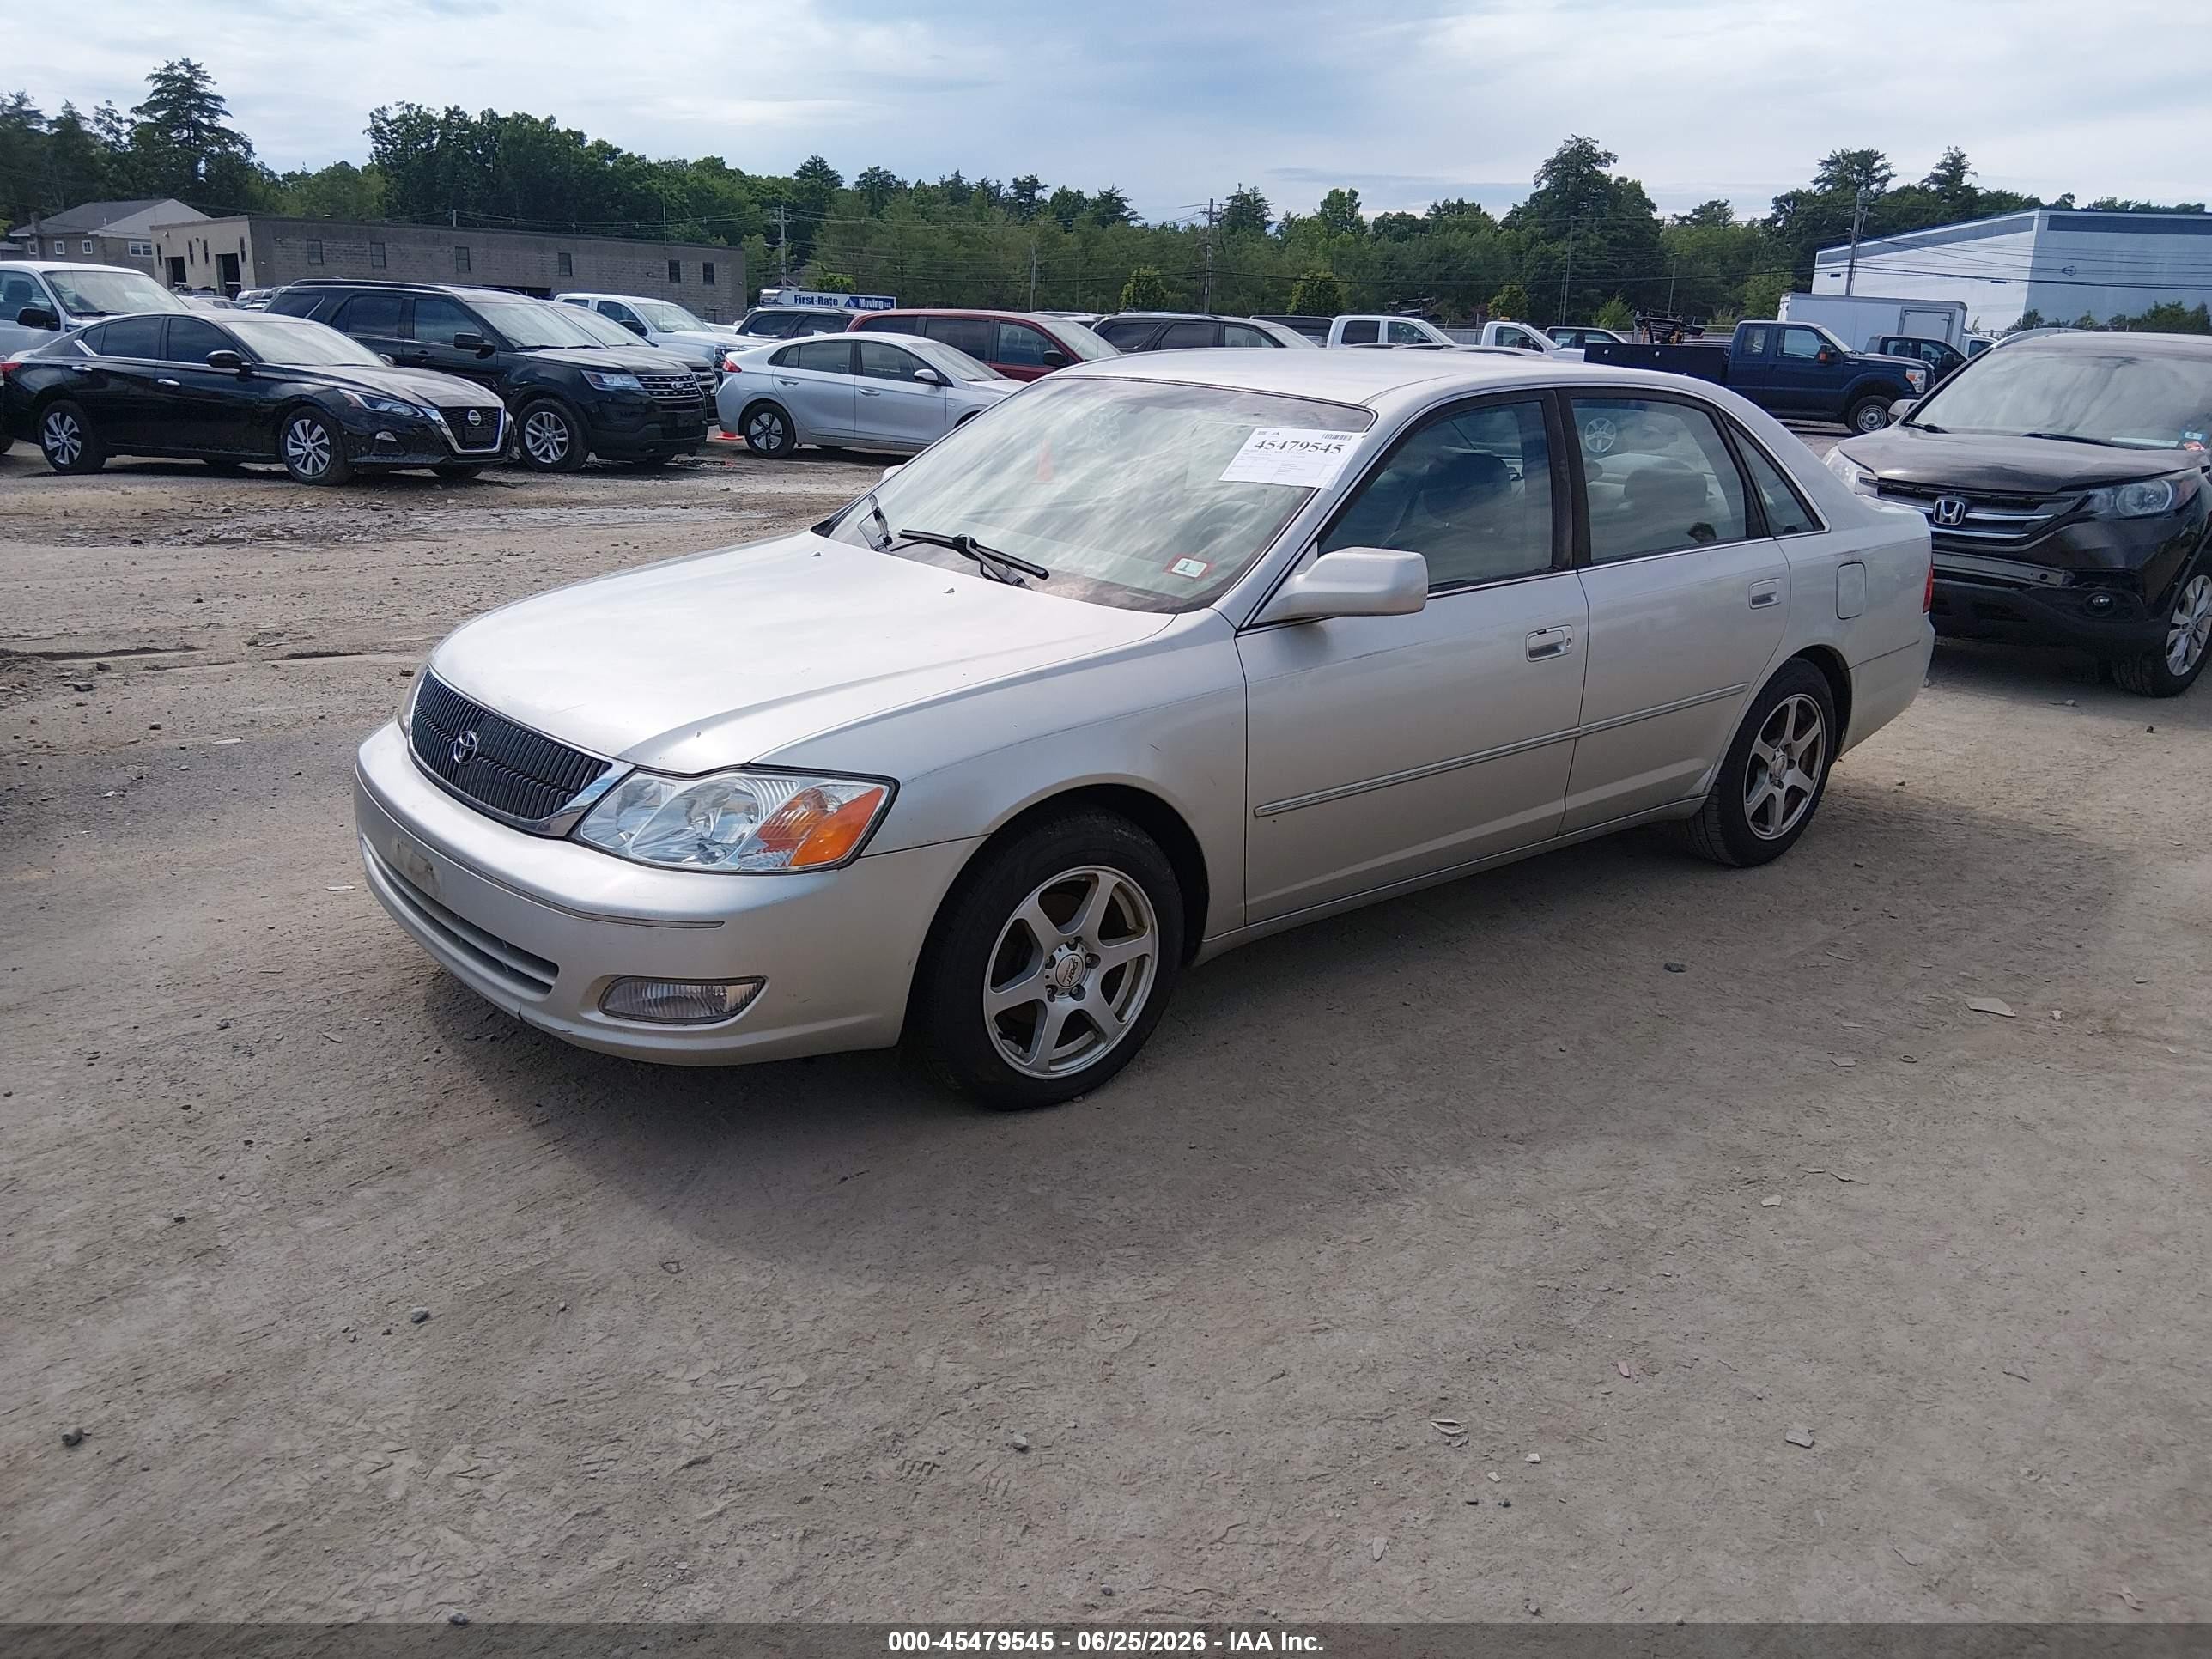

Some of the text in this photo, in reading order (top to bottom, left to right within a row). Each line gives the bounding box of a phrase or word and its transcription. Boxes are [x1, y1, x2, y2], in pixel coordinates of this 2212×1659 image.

[793, 295, 839, 307] First-Rate
[859, 298, 884, 309] Moving
[1255, 439, 1346, 454] 45479545
